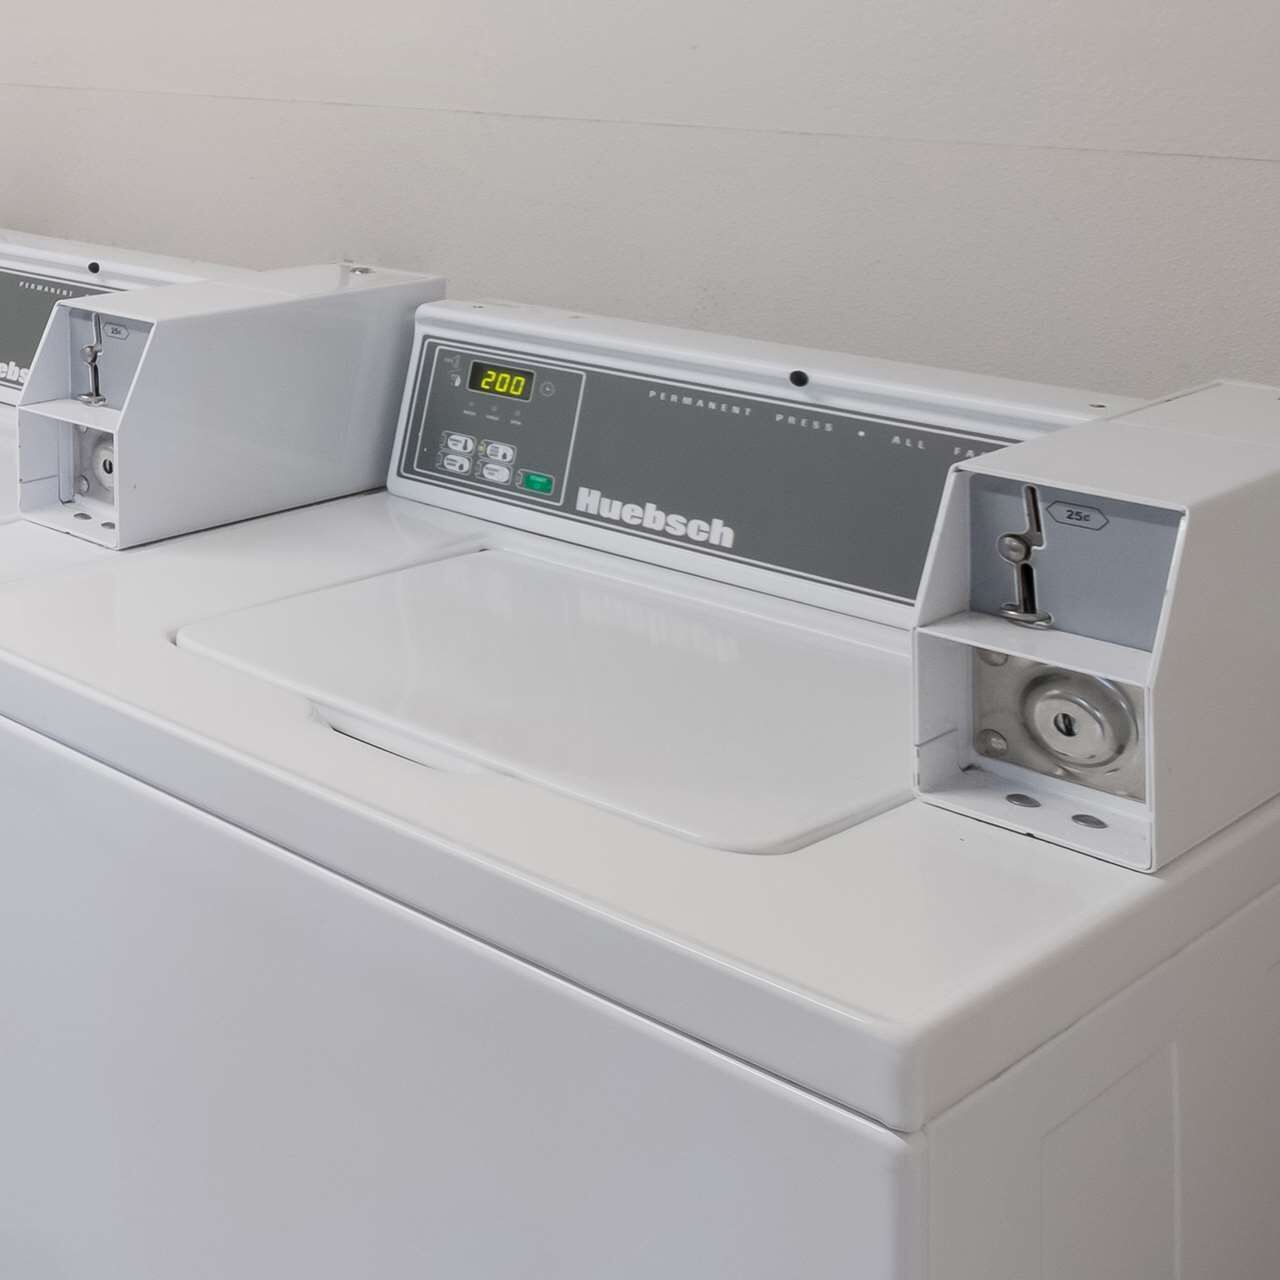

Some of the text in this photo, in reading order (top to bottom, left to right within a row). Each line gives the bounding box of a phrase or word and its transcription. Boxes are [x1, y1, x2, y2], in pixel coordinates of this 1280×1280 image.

[480, 371, 526, 395] 200
[649, 390, 986, 458] PERMANENT PRESS ALL FA
[575, 486, 735, 548] Huebsch
